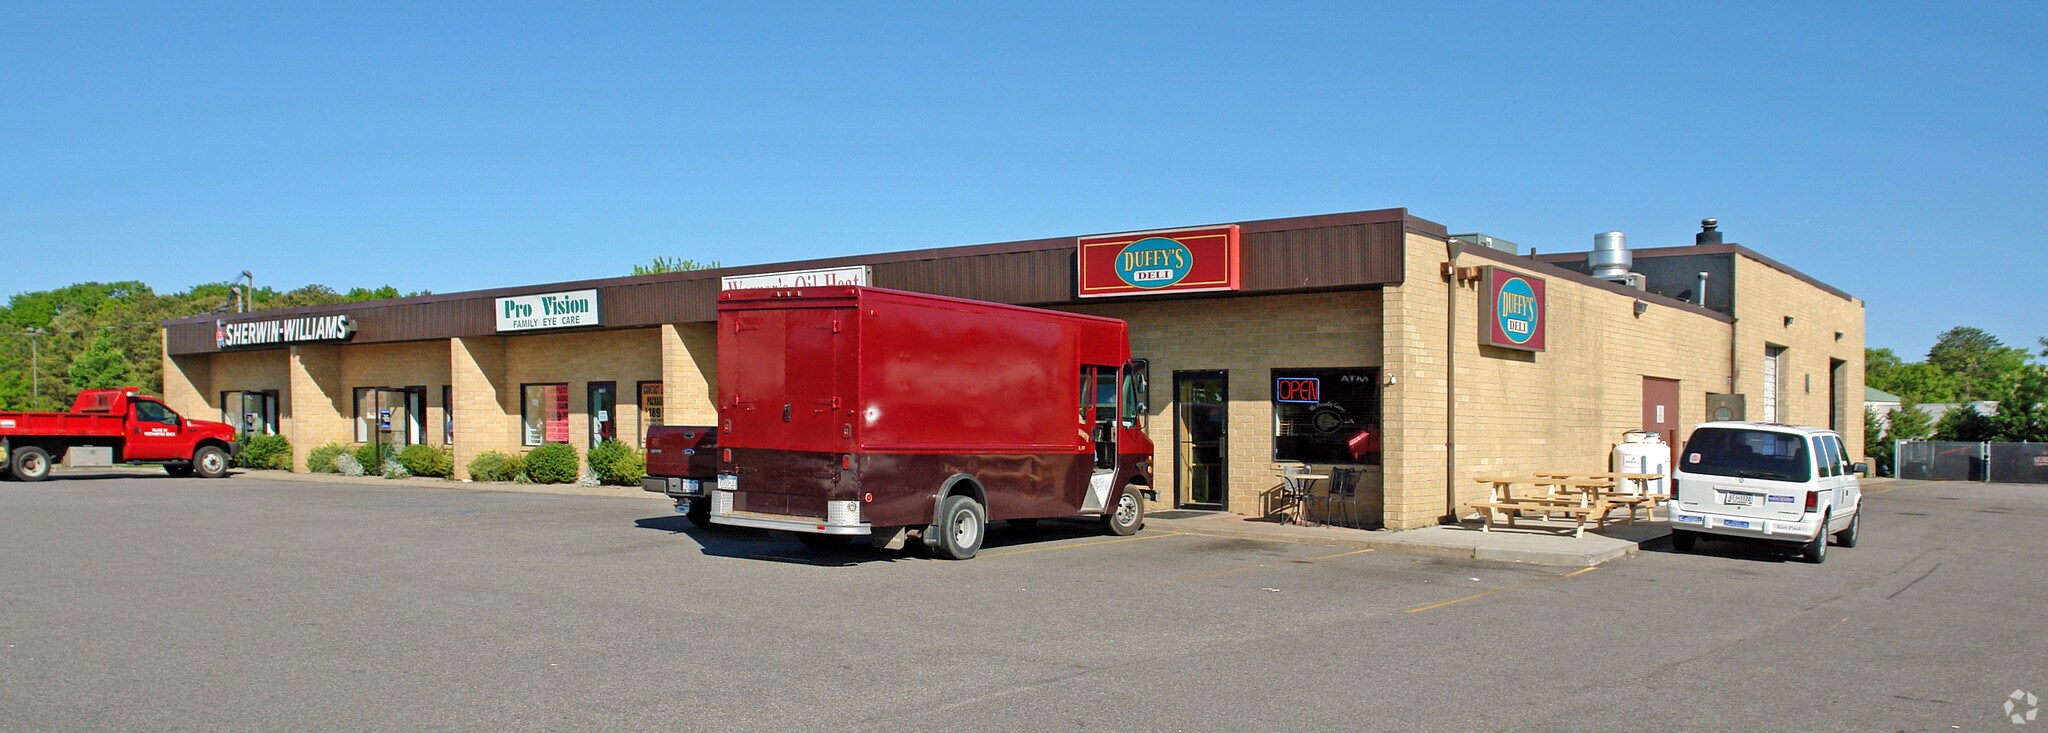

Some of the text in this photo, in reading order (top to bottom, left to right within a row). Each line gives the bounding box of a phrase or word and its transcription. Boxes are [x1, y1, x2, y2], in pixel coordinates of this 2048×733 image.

[1124, 248, 1184, 272] DUFFY'S
[1138, 271, 1169, 280] DELI
[504, 295, 589, 319] Pro Vision
[1502, 292, 1533, 321] DUFFY'S
[225, 314, 346, 346] SHERWIN-WILLIAMS
[513, 316, 580, 328] FAMILY EYE CARE
[1509, 321, 1526, 331] DELI
[1341, 375, 1369, 383] ATM
[1280, 380, 1319, 400] OPEN
